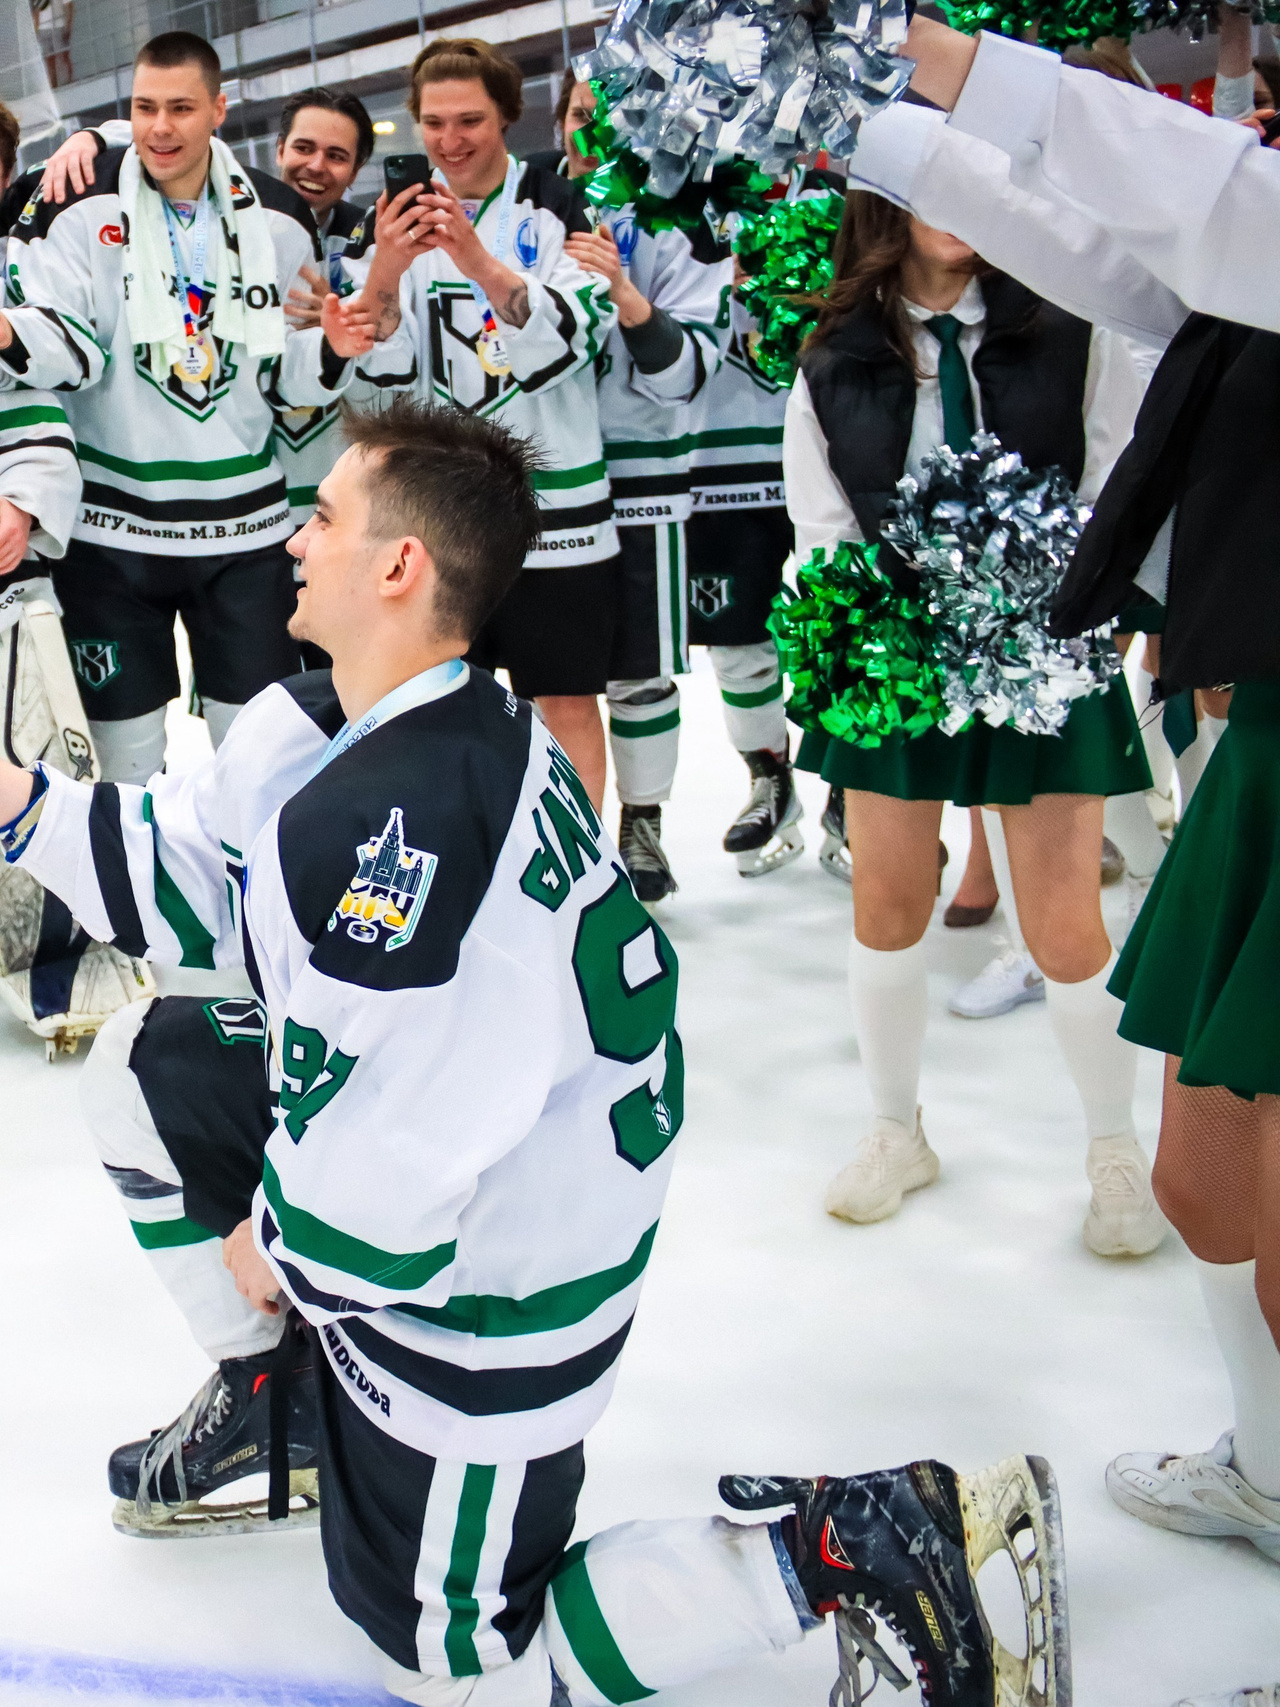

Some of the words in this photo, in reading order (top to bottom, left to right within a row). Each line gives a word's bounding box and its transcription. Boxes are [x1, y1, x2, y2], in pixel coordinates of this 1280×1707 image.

[82, 508, 126, 531] МГУ
[126, 522, 186, 540] имени
[614, 504, 672, 519] носова
[278, 1015, 360, 1146] 97
